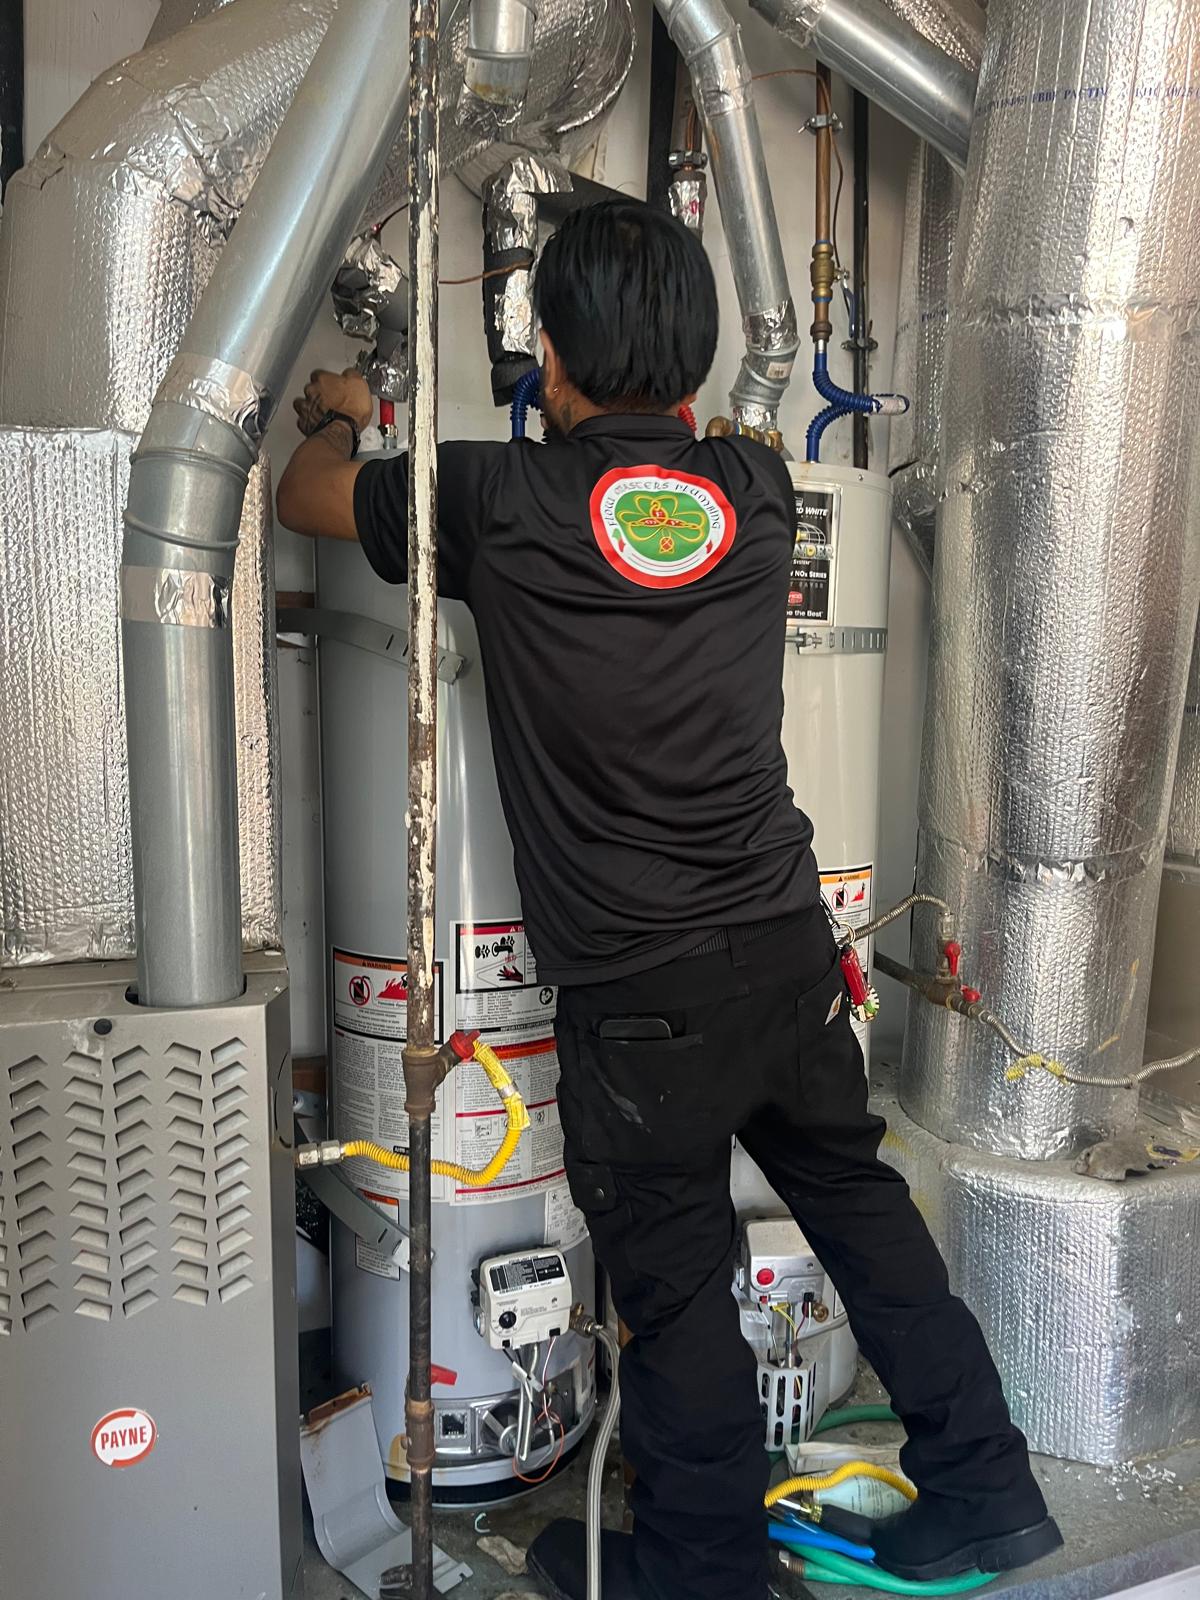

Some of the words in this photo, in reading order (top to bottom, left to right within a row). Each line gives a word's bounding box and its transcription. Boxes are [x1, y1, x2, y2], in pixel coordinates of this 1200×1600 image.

[675, 484, 720, 529] PLUMBING
[805, 506, 828, 516] WHITE
[367, 962, 392, 970] WARNING
[100, 1425, 148, 1450] PAYNE
